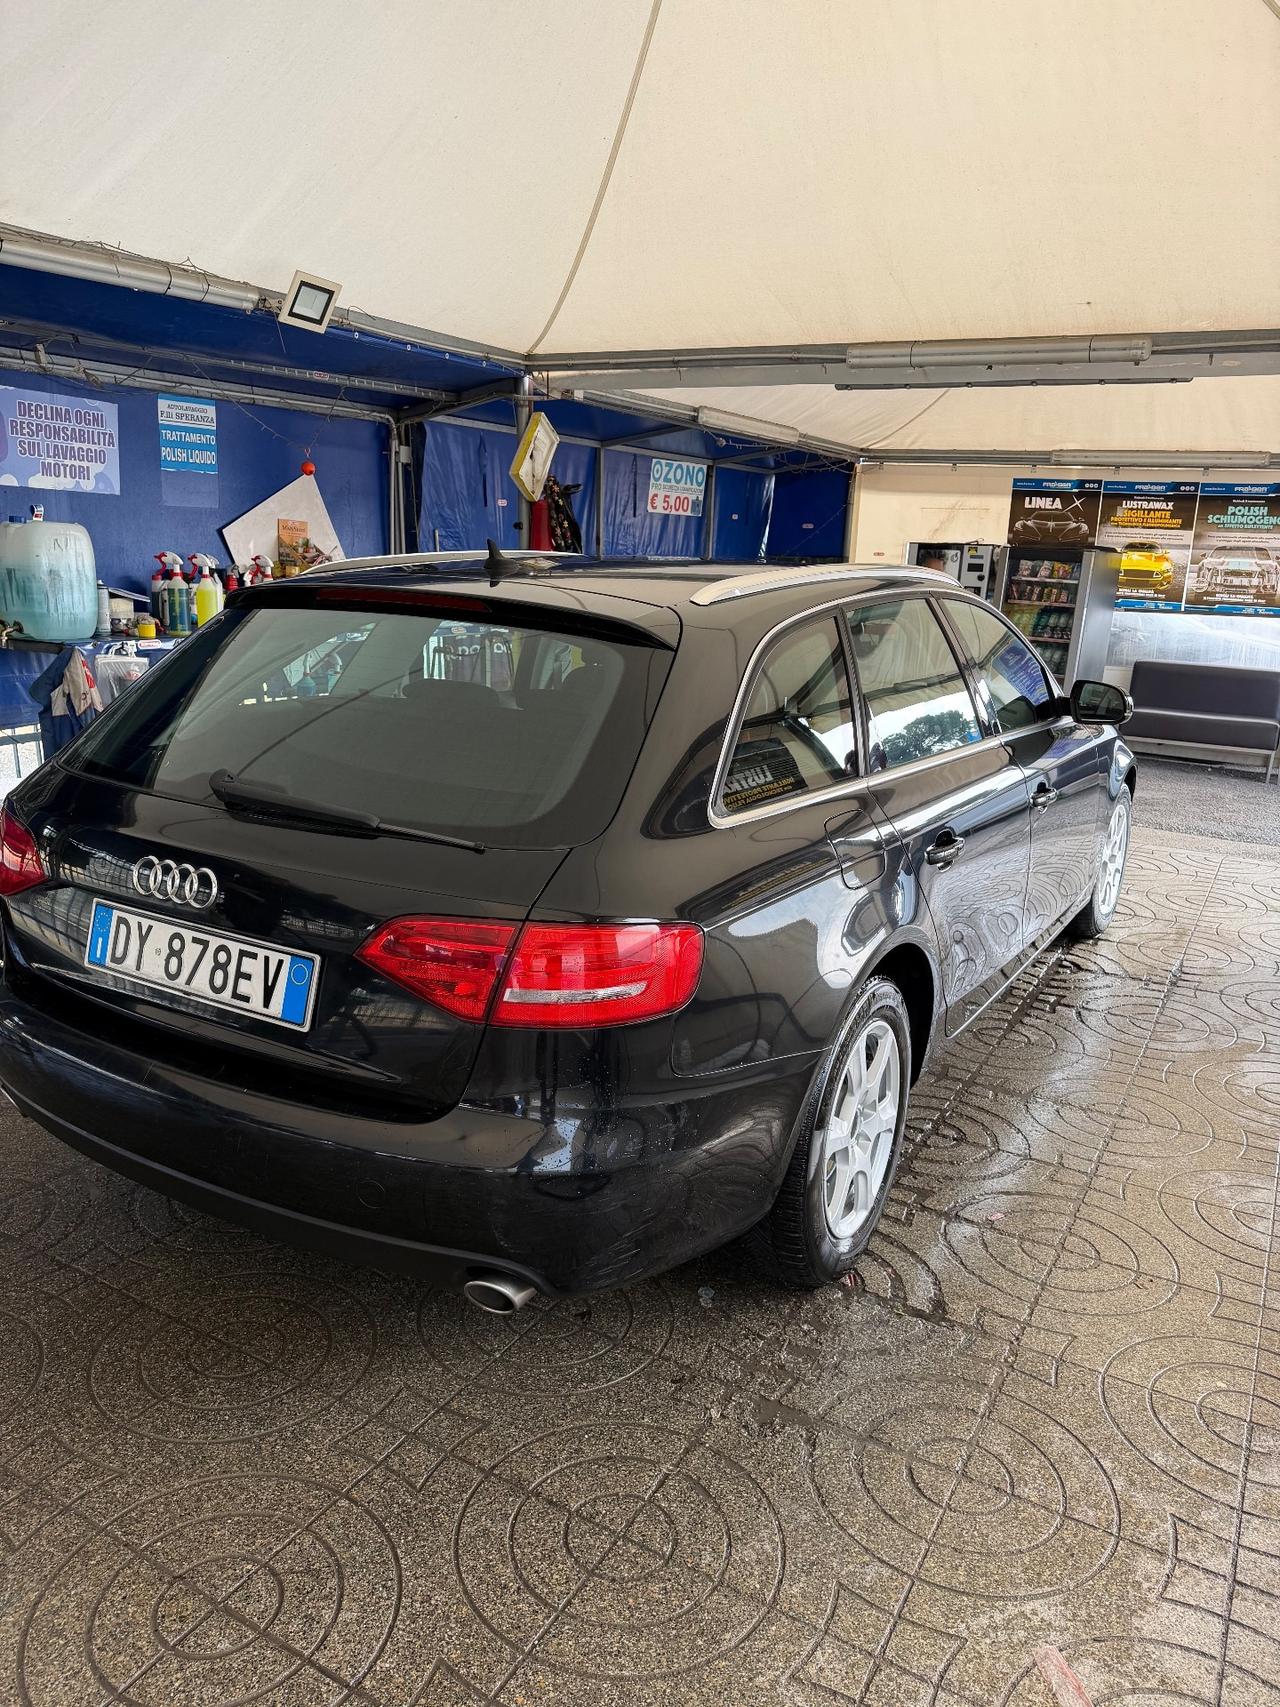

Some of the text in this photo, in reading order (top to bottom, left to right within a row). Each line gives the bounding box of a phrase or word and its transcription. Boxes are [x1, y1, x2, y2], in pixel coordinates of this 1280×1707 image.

[17, 400, 106, 429] DECLINA OGNI
[175, 412, 215, 424] SPERANZA
[9, 418, 116, 448] RESPONSABILITÀ
[161, 430, 216, 445] TRATTAMENTO
[18, 438, 107, 465] SUL LAVAGGIO
[161, 447, 216, 465] POLISH LIQUIDO
[40, 460, 91, 481] MOTORI
[652, 461, 705, 487] OZONO
[650, 493, 689, 512] € 5,00
[1024, 496, 1062, 509] LINEA
[1122, 500, 1174, 510] LUSTRAWAX
[1227, 506, 1268, 515] POLISH
[1123, 509, 1171, 518] SIGILLANTE
[110, 915, 153, 972] DY
[164, 932, 284, 1009] 878EV
